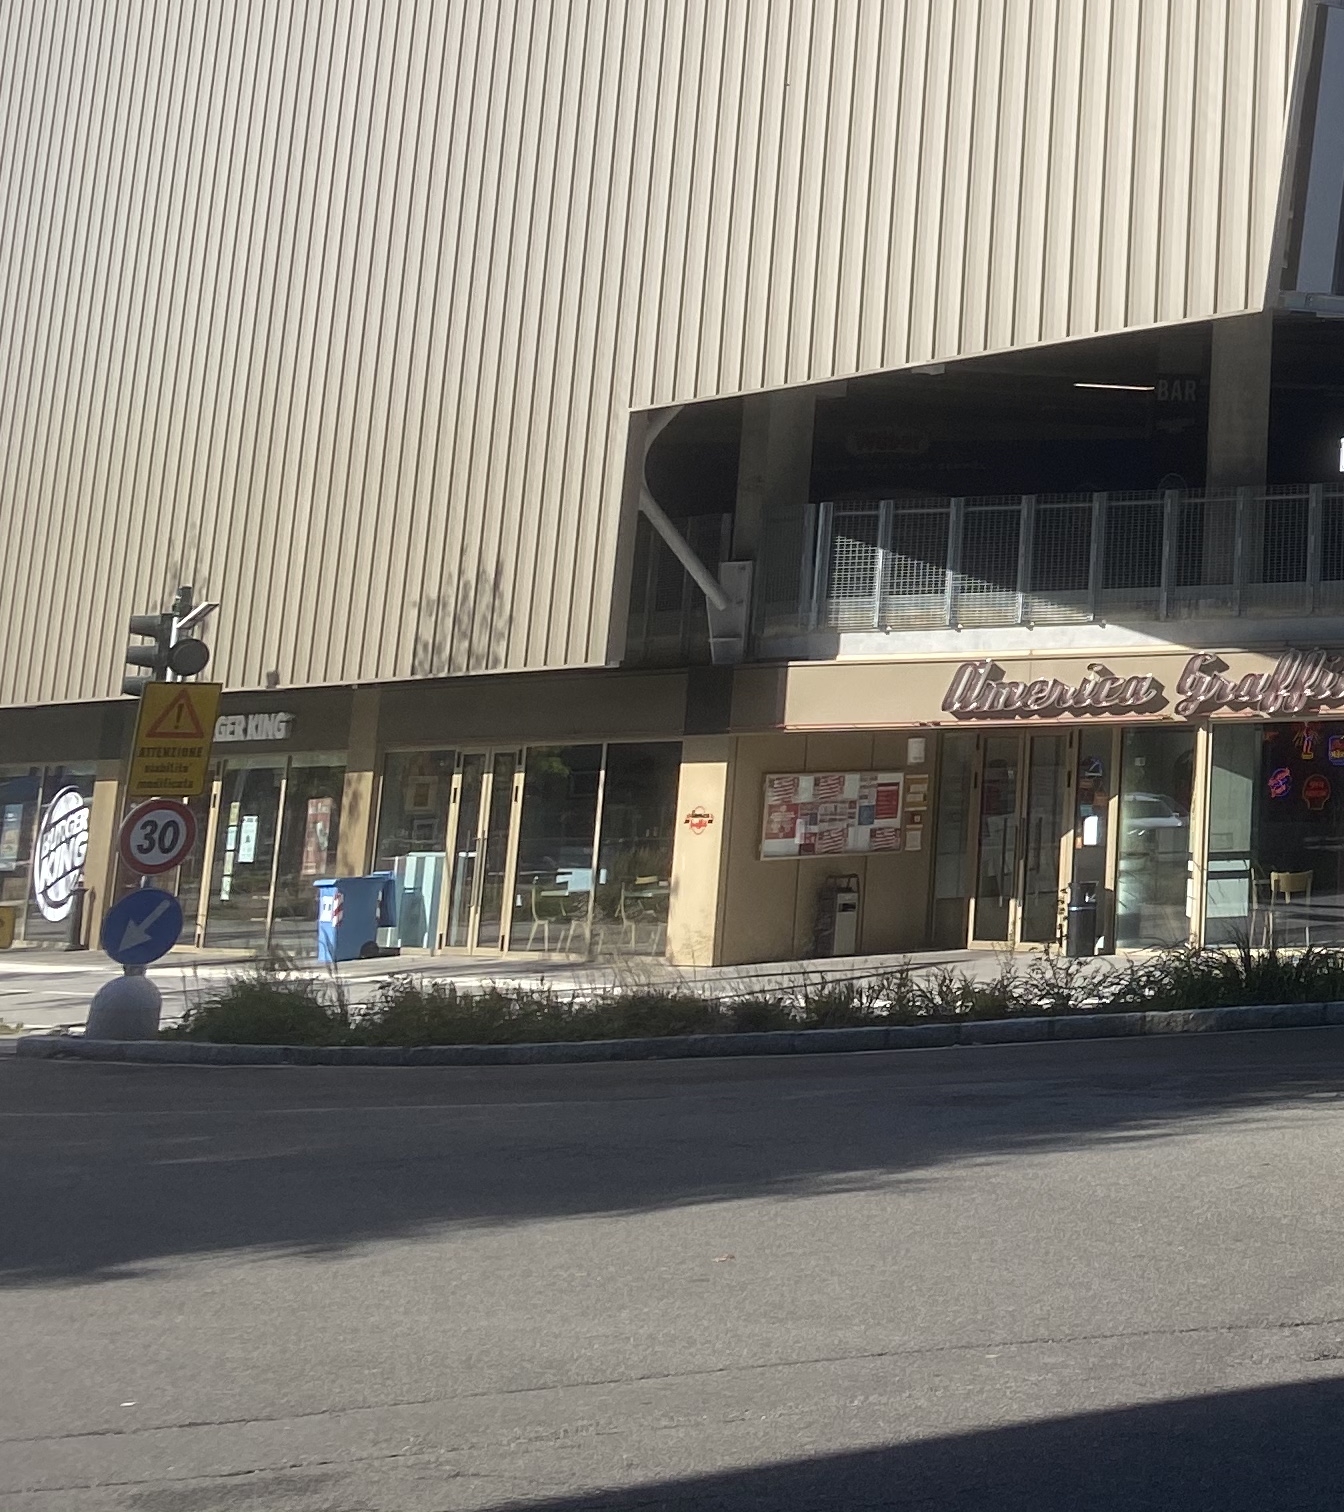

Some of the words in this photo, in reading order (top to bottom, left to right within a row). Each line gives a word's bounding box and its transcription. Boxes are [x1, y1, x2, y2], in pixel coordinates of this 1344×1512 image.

[942, 658, 1158, 714] America
[213, 715, 245, 742] GER
[247, 712, 289, 741] KING
[138, 746, 204, 758] ATTENZIONE
[136, 819, 181, 855] 30
[39, 830, 89, 892] KING
